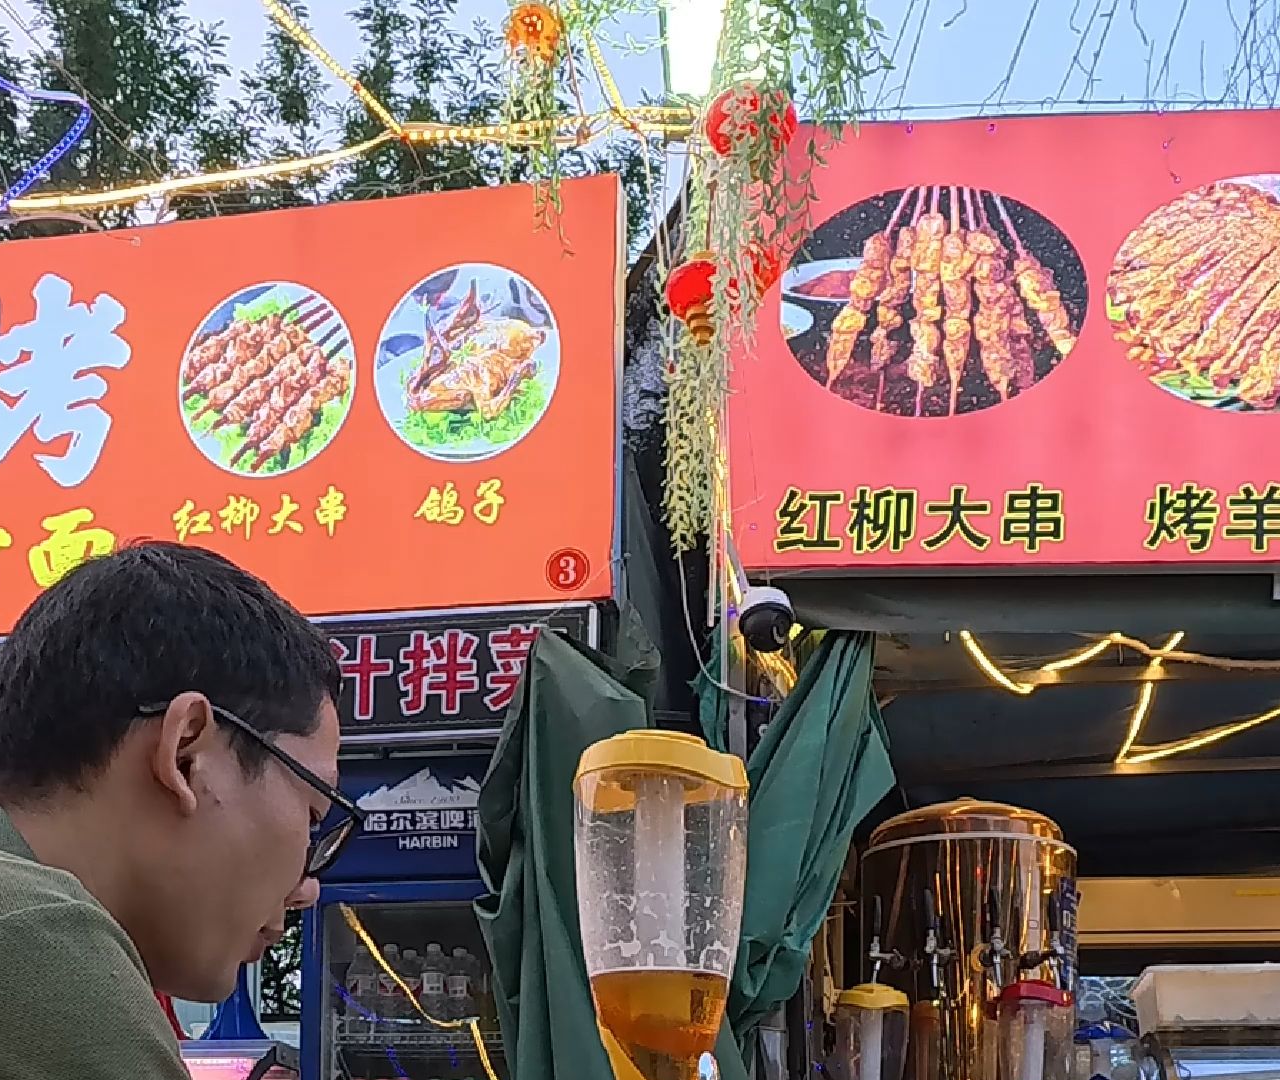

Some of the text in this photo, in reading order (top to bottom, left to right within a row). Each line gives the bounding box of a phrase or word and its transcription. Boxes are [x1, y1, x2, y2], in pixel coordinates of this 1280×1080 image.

[172, 485, 349, 542] 红柳大串
[413, 478, 506, 526] 鸽子
[774, 482, 1066, 554] 红柳大串
[398, 834, 459, 850] HARBIN
